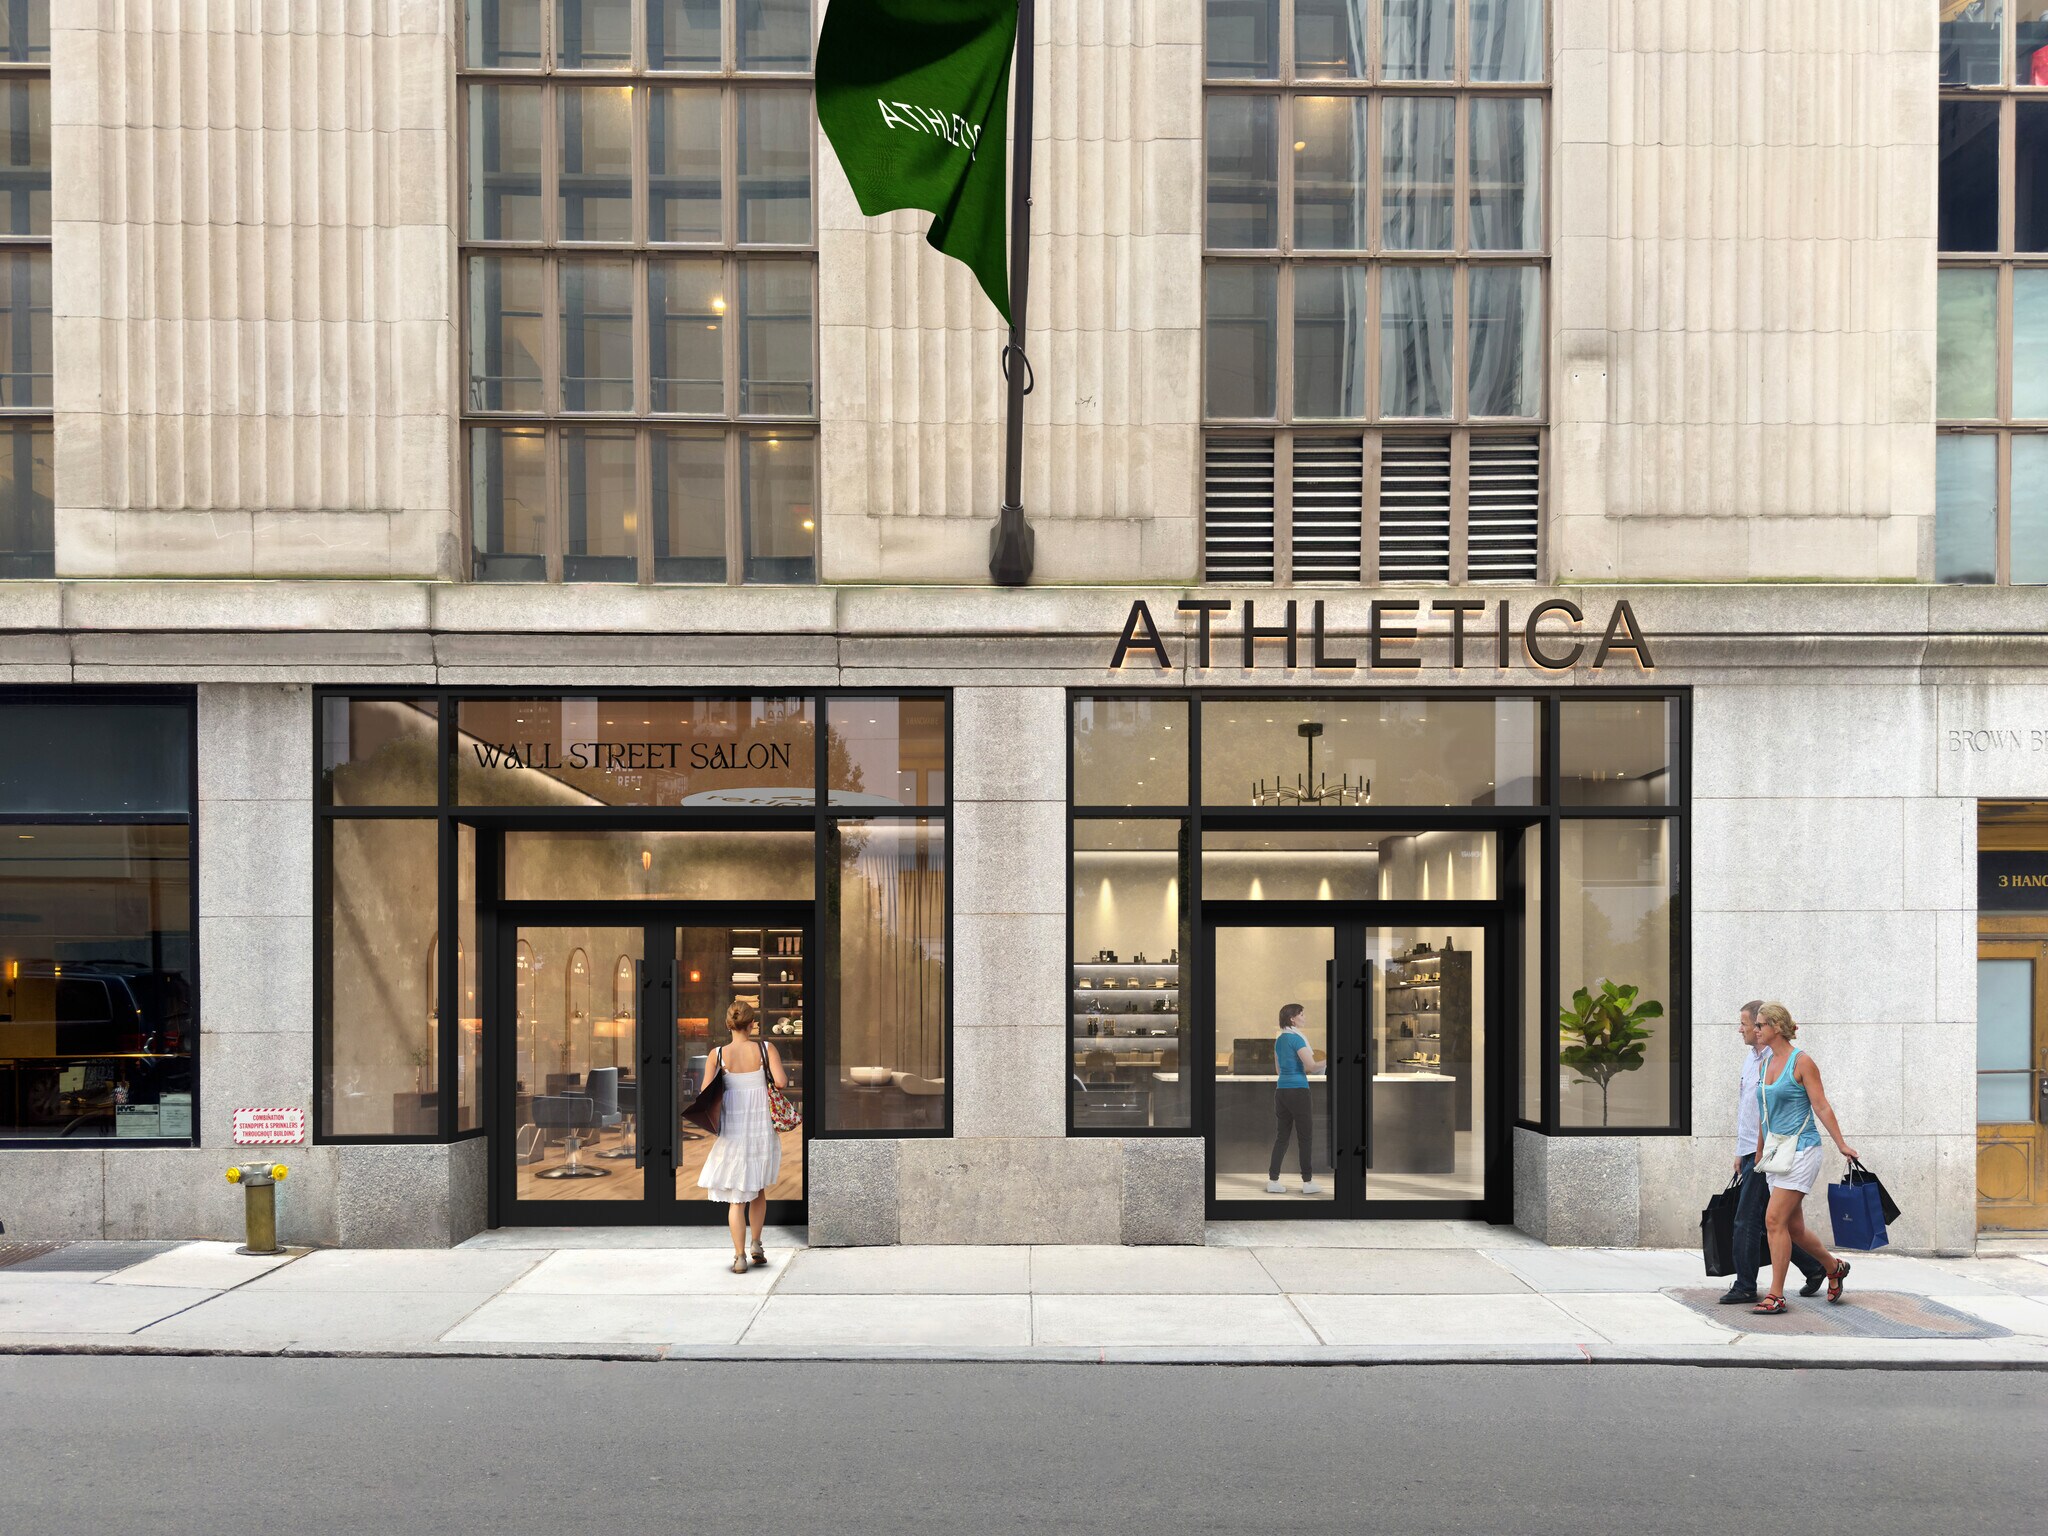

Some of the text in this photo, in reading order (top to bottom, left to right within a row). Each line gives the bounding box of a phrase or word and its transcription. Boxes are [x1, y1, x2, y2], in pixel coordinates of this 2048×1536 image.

[1109, 599, 1655, 670] ATHLETICA
[1949, 730, 2021, 752] BROWN
[473, 743, 791, 769] WALL STREET SALON
[1999, 875, 2008, 887] 3
[242, 1130, 272, 1138] THROUGHOUT
